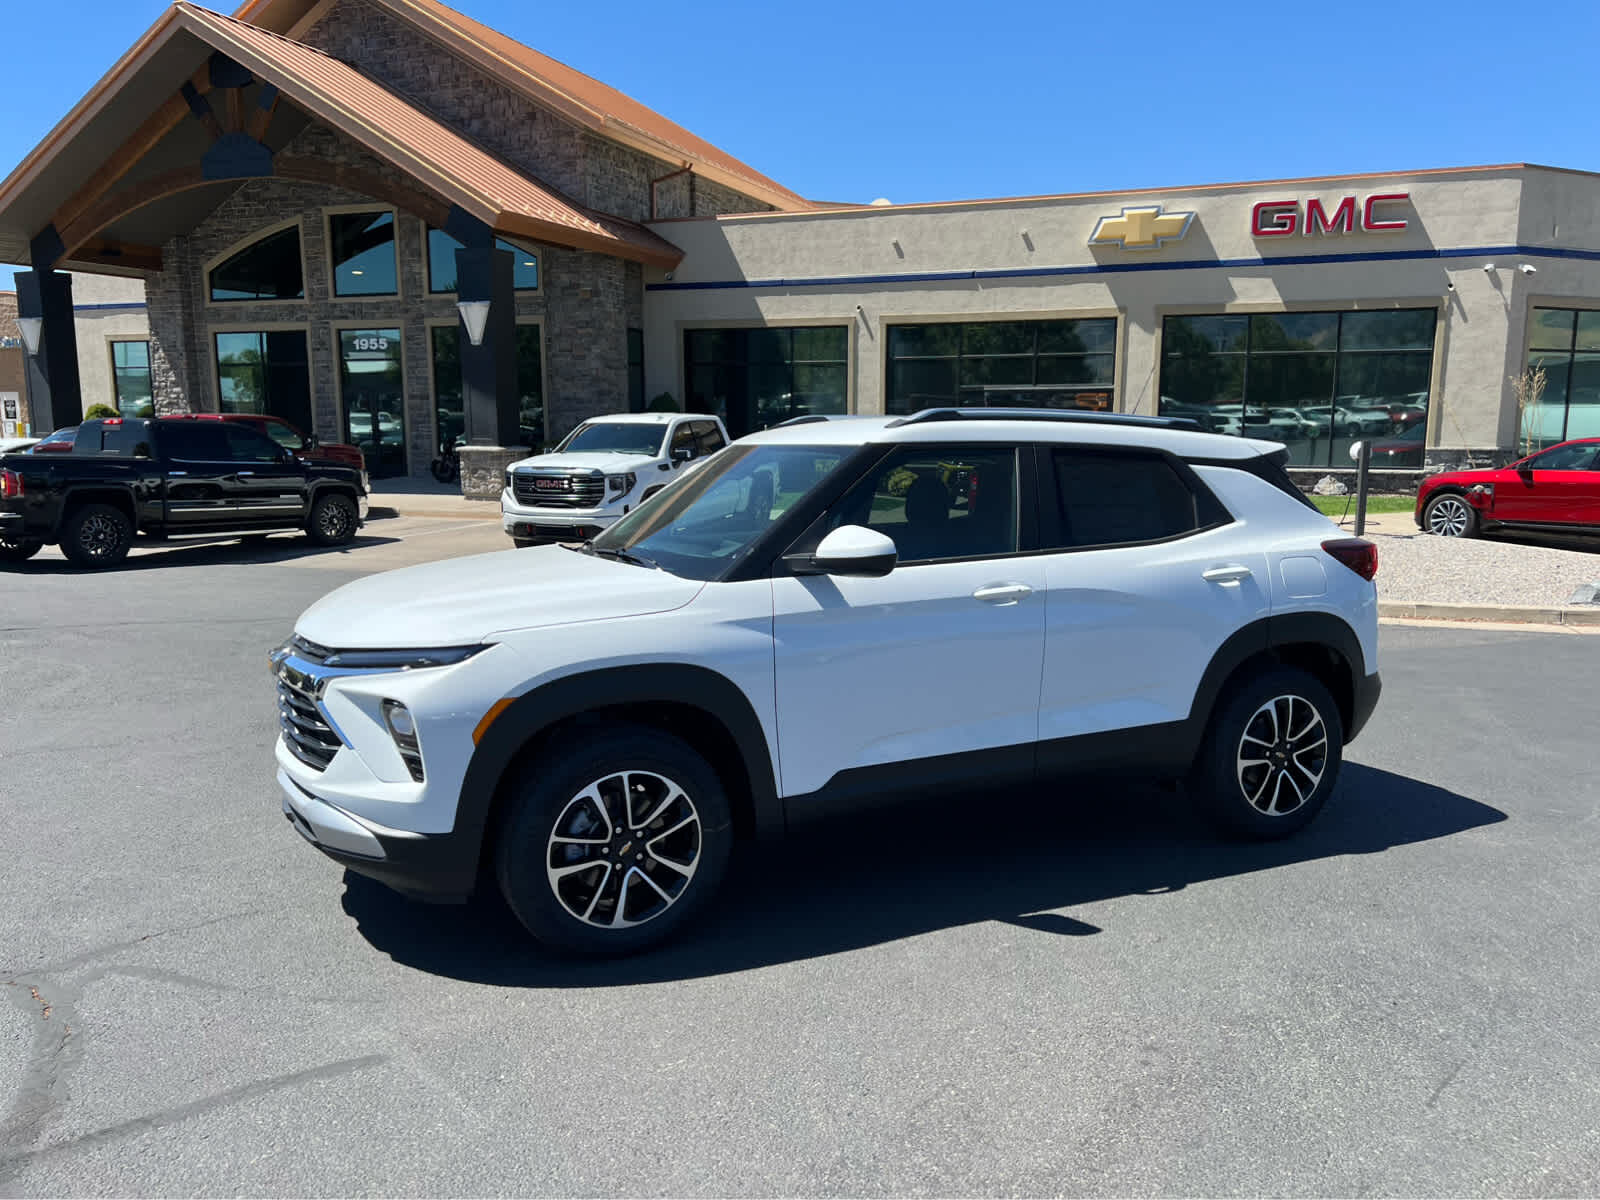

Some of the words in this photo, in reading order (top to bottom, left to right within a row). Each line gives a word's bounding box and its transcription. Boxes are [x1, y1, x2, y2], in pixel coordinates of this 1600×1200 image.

[1251, 193, 1410, 237] GMC
[352, 338, 388, 350] 1955
[535, 479, 569, 489] GMC
